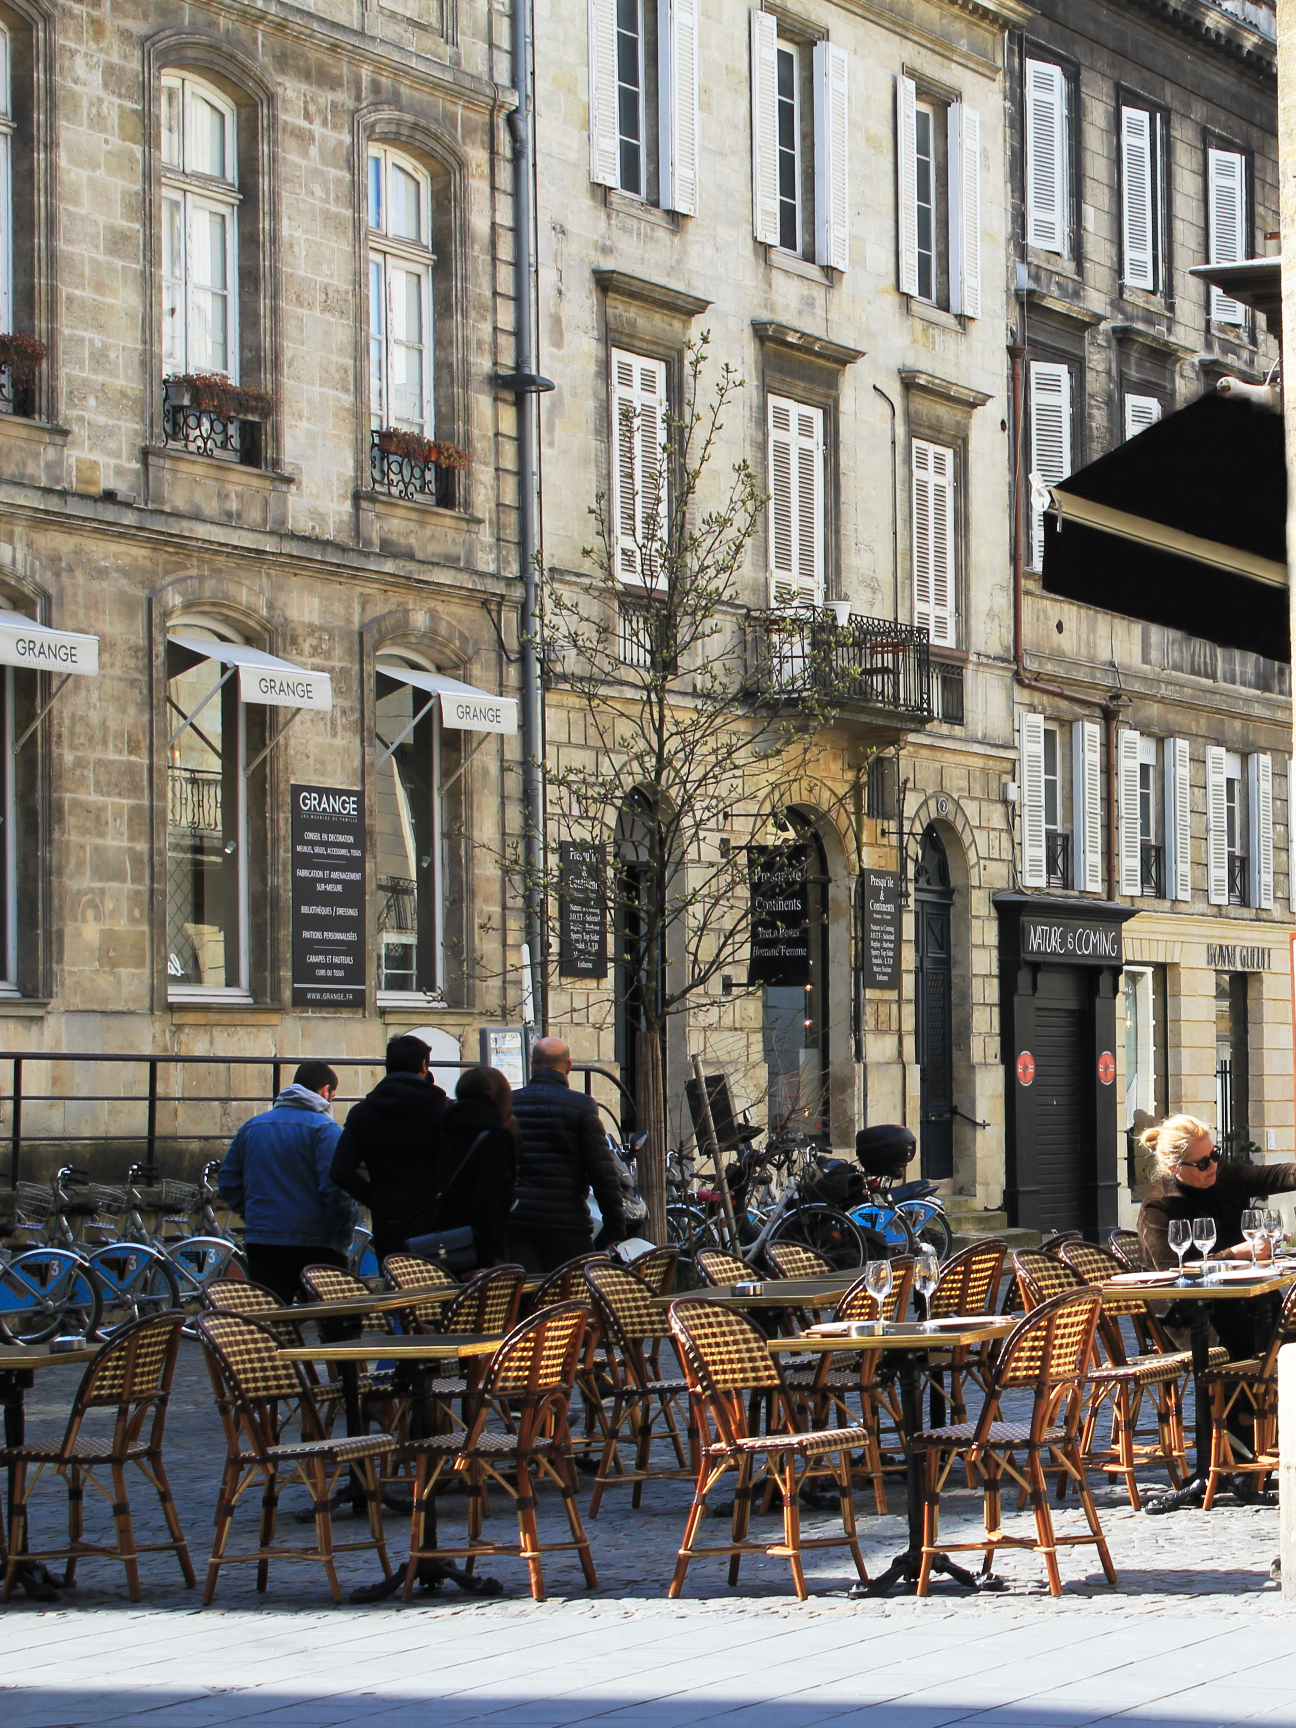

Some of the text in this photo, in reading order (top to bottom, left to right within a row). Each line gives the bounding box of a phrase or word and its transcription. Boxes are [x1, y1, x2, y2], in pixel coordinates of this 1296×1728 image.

[16, 638, 78, 664] GRANGE
[259, 678, 314, 699] GRANGE
[456, 704, 502, 723] GRANGE
[300, 791, 358, 815] GRANGE
[304, 831, 321, 841] CONSEIL
[321, 833, 328, 842] EN
[296, 868, 324, 879] FABRICATION
[324, 871, 330, 880] ET
[316, 883, 343, 893] SUR-MESURE
[755, 896, 802, 912] Continents
[1029, 924, 1066, 954] NATURE
[781, 945, 808, 956] Femme
[326, 955, 332, 964] ET
[307, 992, 353, 1001] WWW.GRANGE.FR
